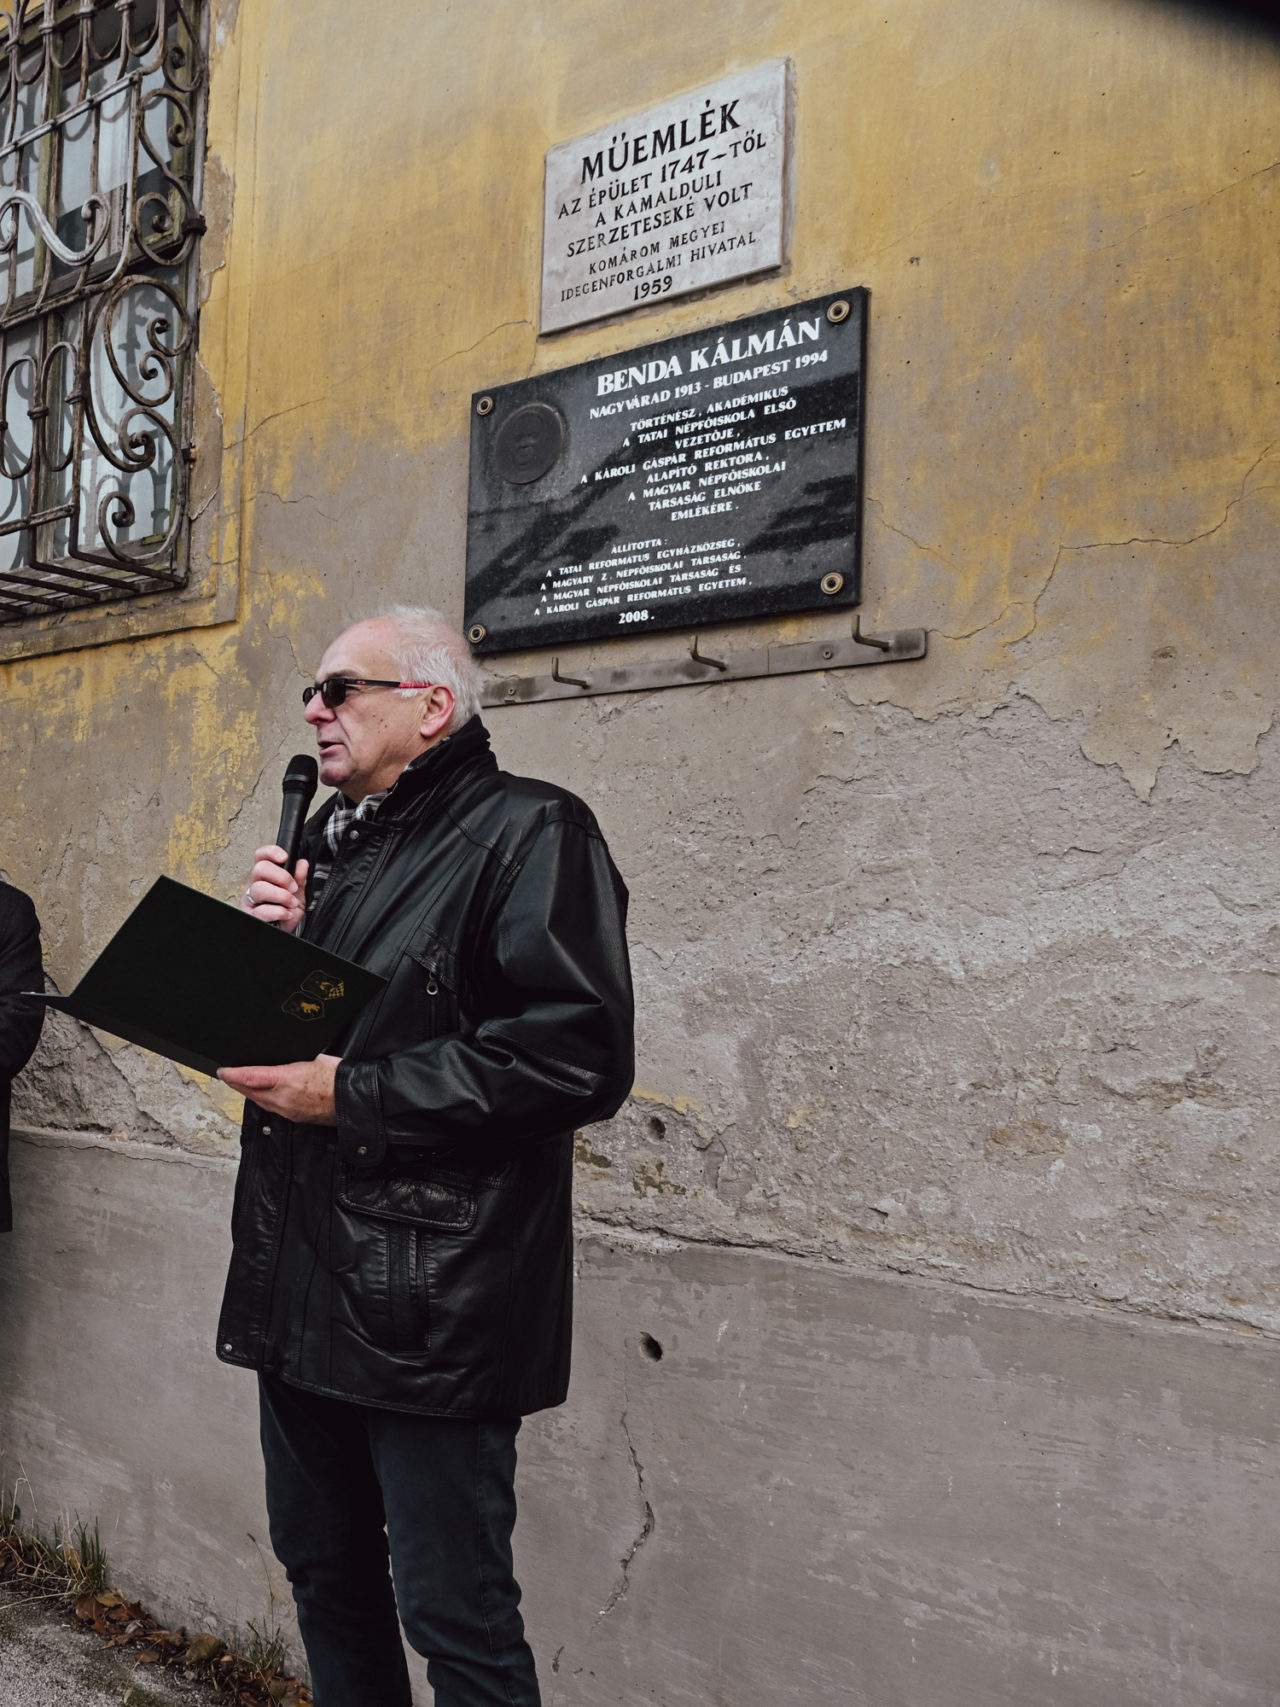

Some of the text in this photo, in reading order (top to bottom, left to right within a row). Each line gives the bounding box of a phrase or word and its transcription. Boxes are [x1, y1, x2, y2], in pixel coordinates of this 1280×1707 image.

[580, 99, 741, 186] MŰEMLÉK
[557, 197, 582, 220] AZ
[588, 172, 653, 209] ÉPÜLET
[566, 182, 753, 258] SZERZETESEKÉ VOLT
[594, 169, 722, 228] A KAMALDULI
[560, 231, 756, 302] IDEGENFORGALMI HIVATAL
[588, 220, 725, 275] KOMÁROM MEGYEI
[633, 275, 673, 301] 1959
[589, 389, 671, 420] NAGYVÁRAD
[674, 381, 701, 399] 1913
[713, 359, 791, 389] BUDAPEST
[795, 349, 828, 369] 1994
[596, 317, 821, 397] BENDA KÁLMÁN
[706, 385, 789, 414] AKADÉMIKUS
[580, 417, 846, 484] A KÁROLI GÁSPÁR REFORMÁTUS EGYETEM
[622, 437, 630, 447] A
[637, 428, 668, 444] TATAI
[628, 491, 636, 502] A
[643, 480, 691, 498] MAGYAR
[646, 463, 697, 484] ALAPÍTÓ
[648, 480, 762, 511] TÁRSASÁG ELNÖKE
